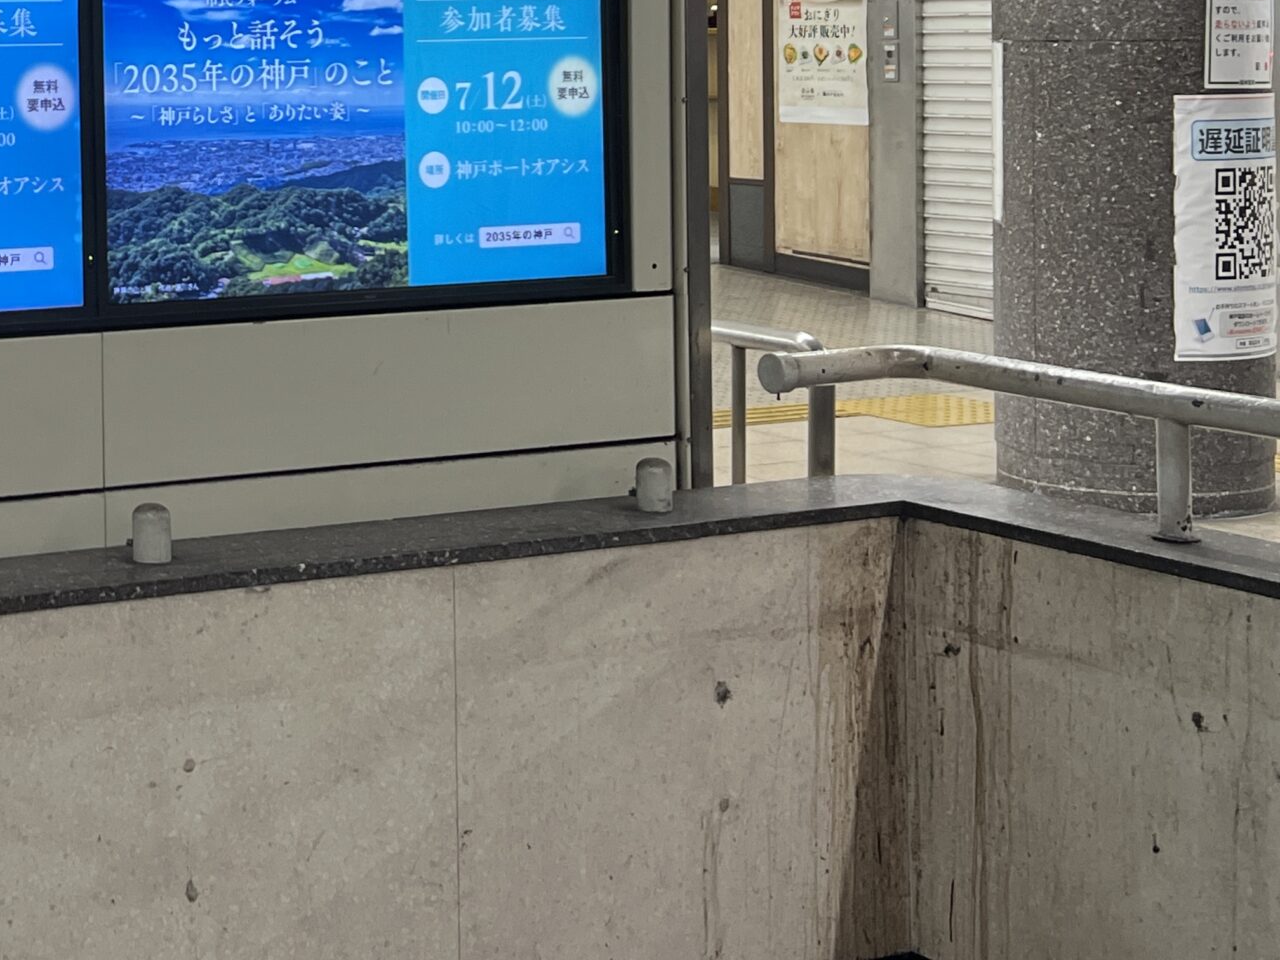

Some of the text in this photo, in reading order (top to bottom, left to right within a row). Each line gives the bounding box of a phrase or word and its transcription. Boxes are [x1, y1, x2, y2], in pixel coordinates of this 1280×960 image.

[440, 5, 566, 33] 参加者募集
[804, 8, 840, 21] おにぎり
[178, 19, 324, 51] もっと話そう
[113, 58, 394, 94] 「2035年の神戸」のこと
[562, 70, 583, 83] 無料
[33, 80, 58, 94] 無料
[557, 86, 590, 100] 要申込
[27, 98, 65, 112] 要申込
[455, 158, 589, 180] 神戸ポートオアシス
[434, 229, 553, 246] 詳しくは 2035年の神戸
